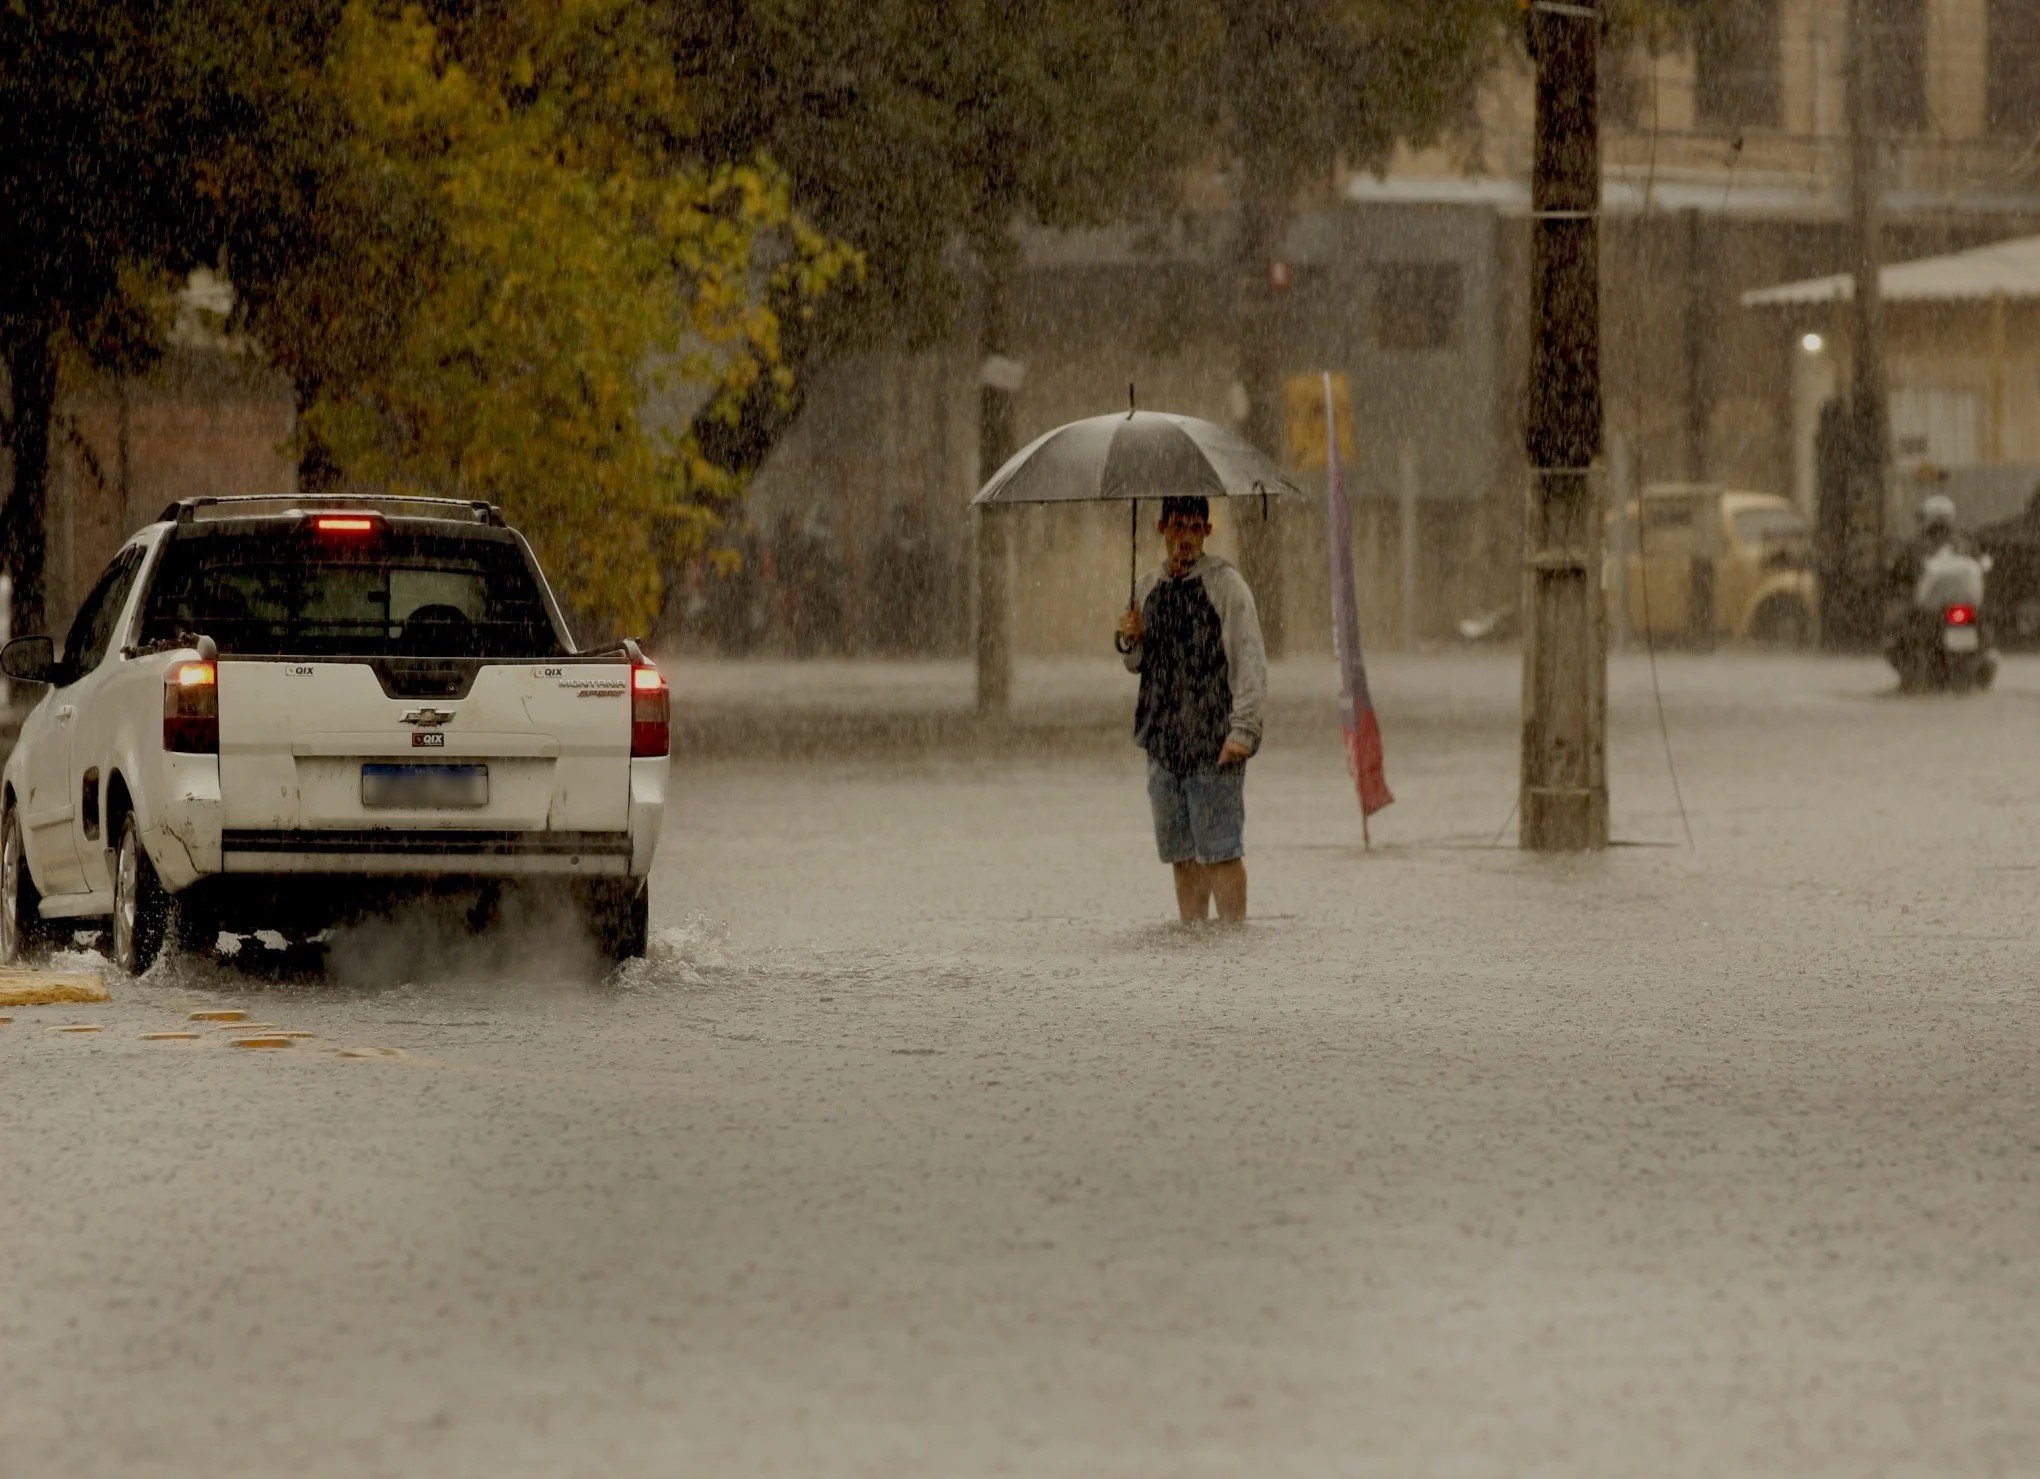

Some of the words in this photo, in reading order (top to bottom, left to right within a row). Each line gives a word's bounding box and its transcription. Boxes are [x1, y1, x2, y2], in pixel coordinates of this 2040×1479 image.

[295, 667, 314, 675] QIX
[544, 668, 562, 676] QIX
[559, 680, 626, 689] MONTANA
[423, 734, 443, 744] QIX
